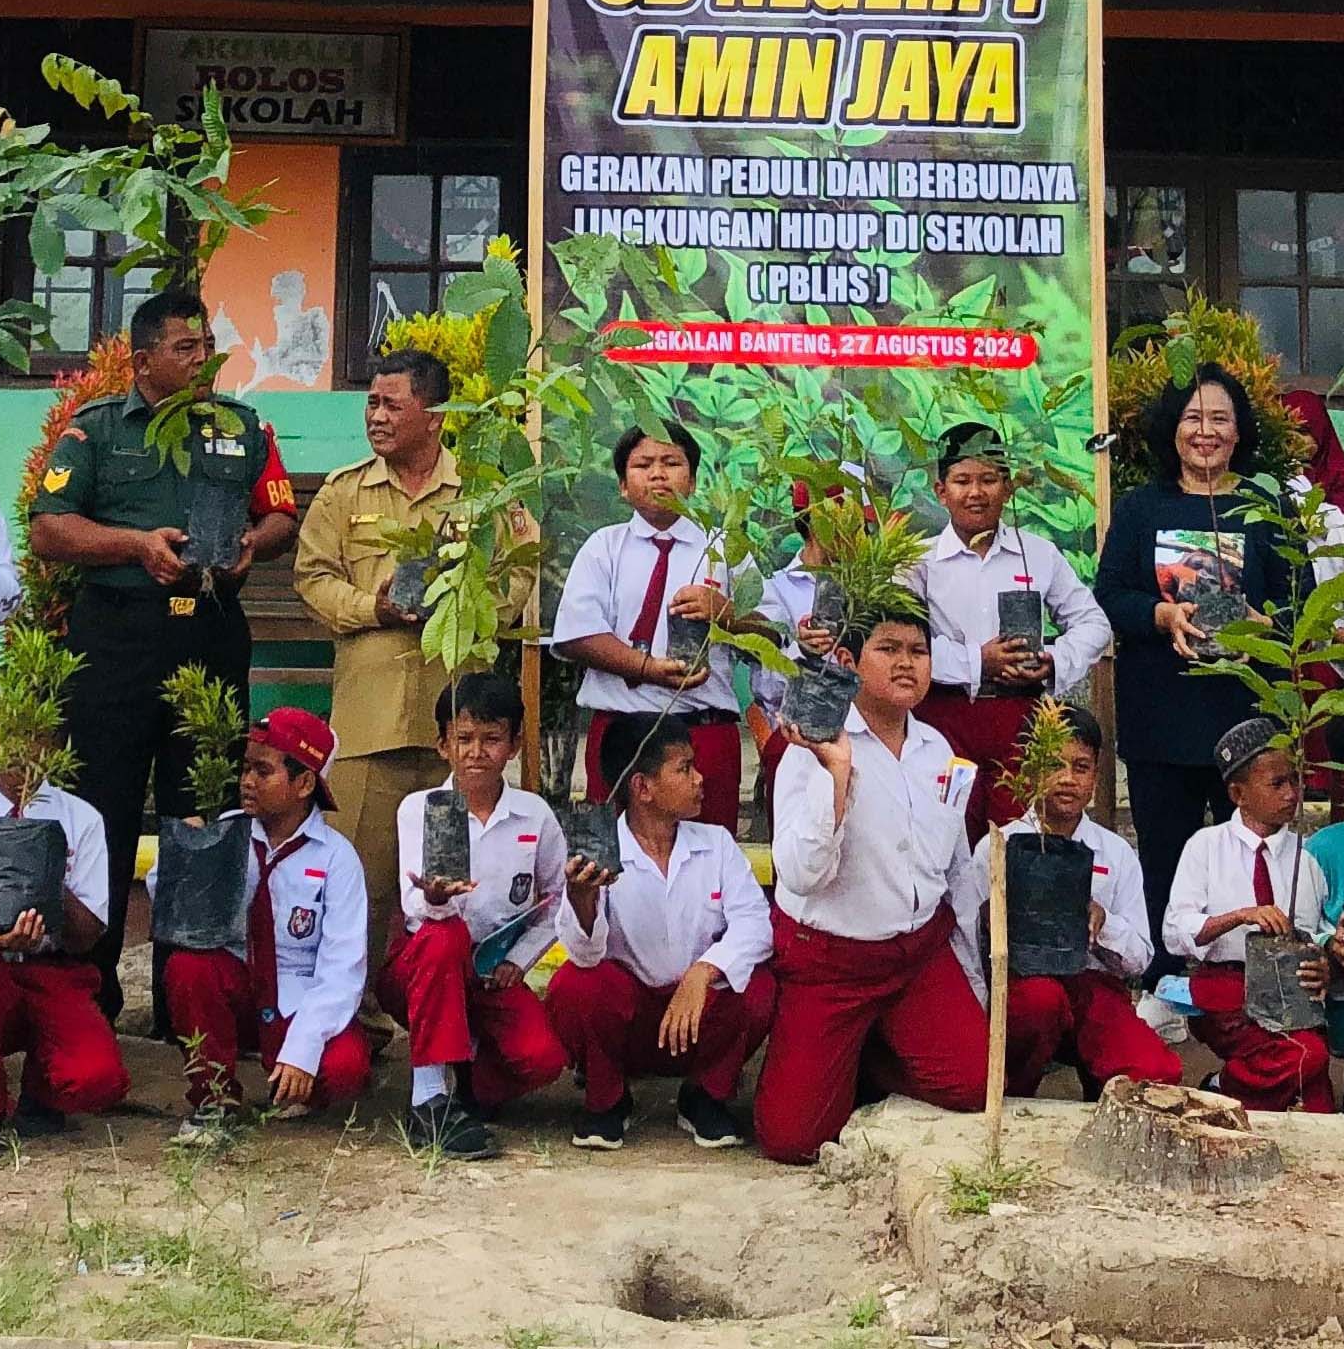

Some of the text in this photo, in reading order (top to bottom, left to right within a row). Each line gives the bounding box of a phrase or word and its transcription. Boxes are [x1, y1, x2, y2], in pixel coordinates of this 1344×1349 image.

[621, 32, 1018, 126] AMIN JAYA
[560, 154, 1077, 202] GERAKAN PEDULI DAN BERBUDAYA
[780, 211, 879, 250] HIDUP
[885, 213, 918, 251] DI
[925, 214, 1062, 254] SEKOLAH
[739, 331, 837, 357] BANTENG,
[840, 334, 873, 355] 27
[874, 334, 967, 357] AGUSTUS
[972, 335, 1024, 358] 2024
